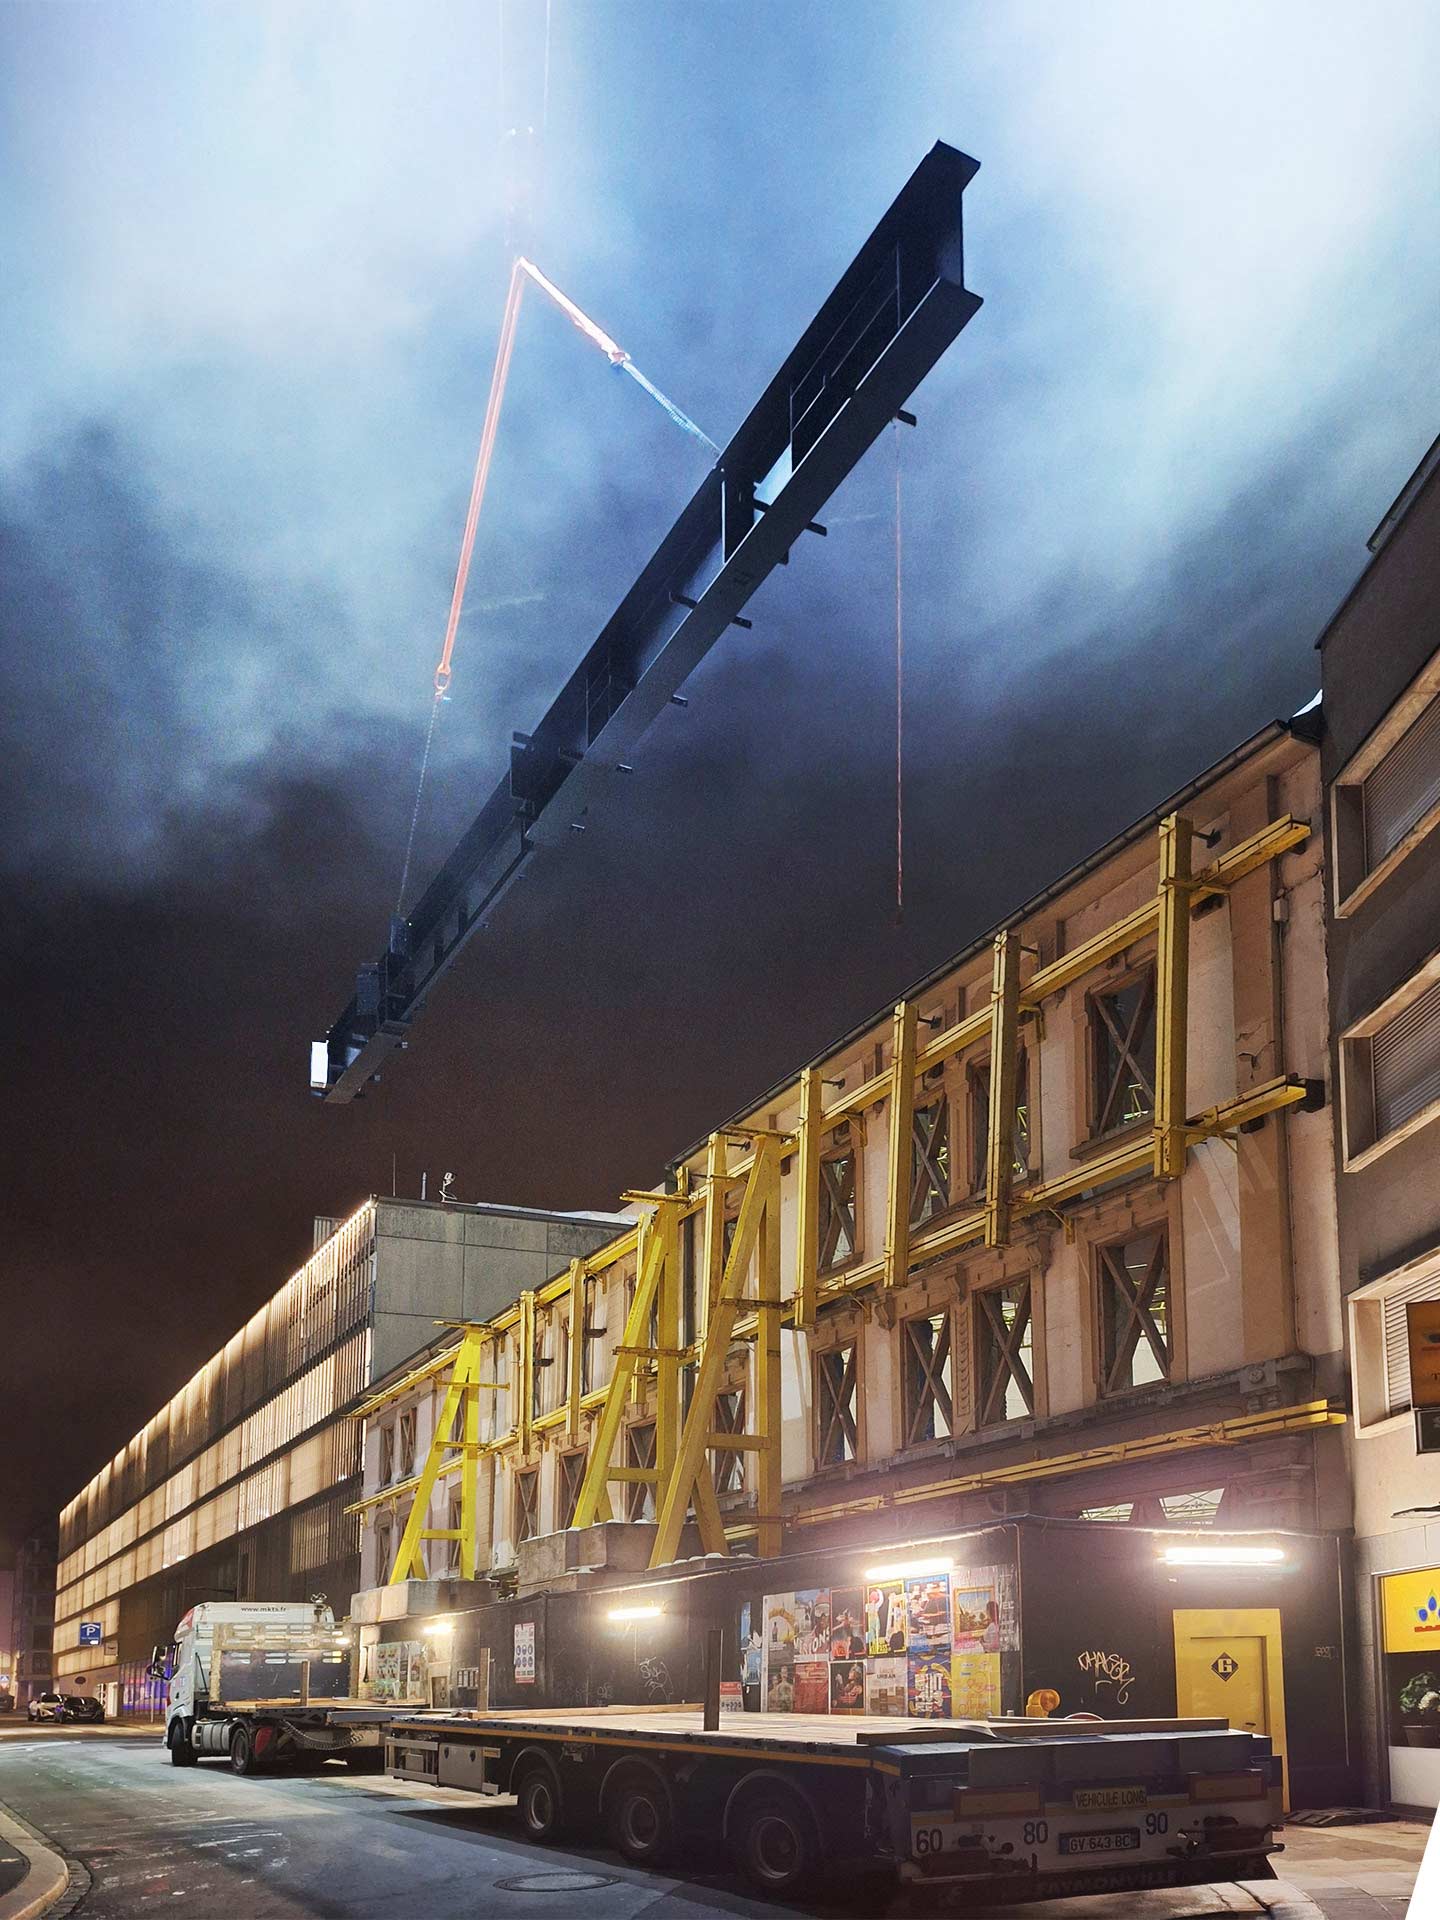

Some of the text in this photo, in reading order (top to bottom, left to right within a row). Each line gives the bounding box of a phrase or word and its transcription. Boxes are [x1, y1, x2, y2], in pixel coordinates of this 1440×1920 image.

[86, 1627, 96, 1637] P
[1023, 1820, 1049, 1845] 80
[1145, 1813, 1169, 1836] 90
[916, 1829, 943, 1854] 60
[1070, 1834, 1130, 1852] GV 643 BC
